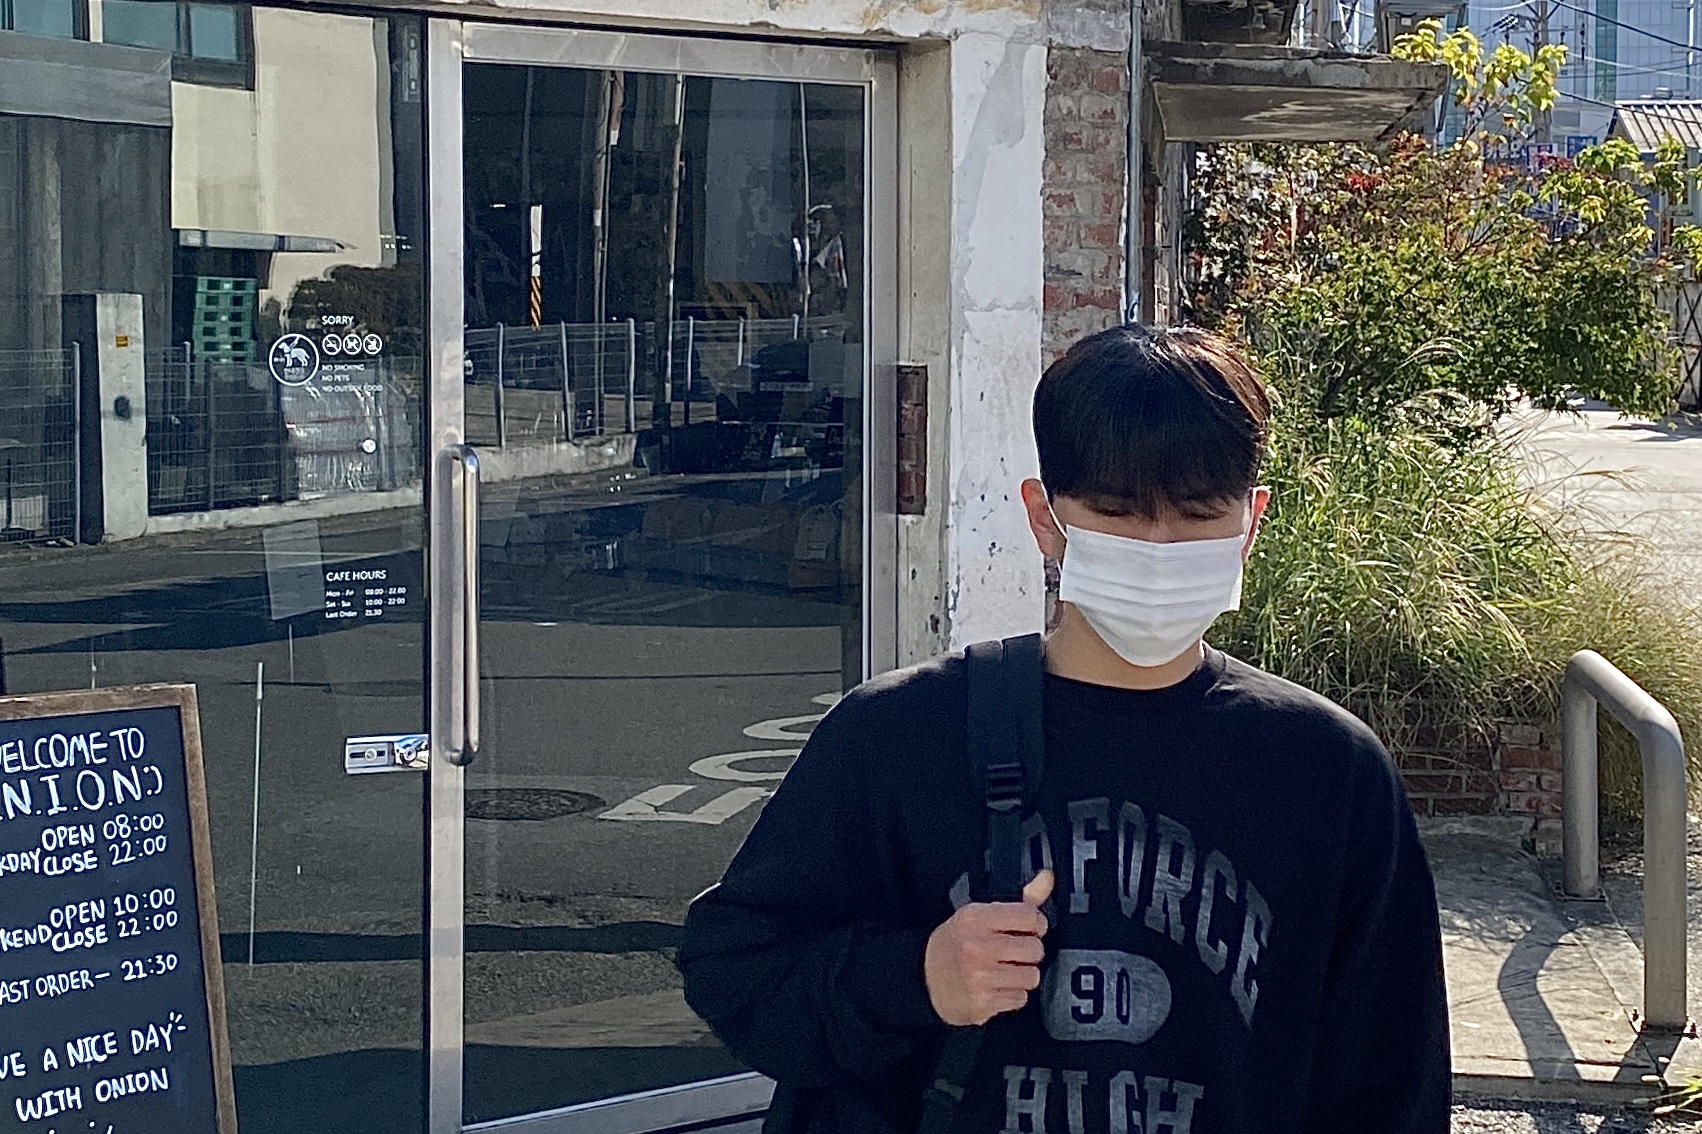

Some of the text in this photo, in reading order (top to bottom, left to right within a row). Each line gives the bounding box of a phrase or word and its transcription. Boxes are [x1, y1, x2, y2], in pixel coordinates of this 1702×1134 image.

[322, 315, 354, 325] SORRY
[321, 374, 350, 382] NO PETS
[326, 570, 387, 581] CAFE HOURS
[325, 600, 336, 608] Sat
[345, 589, 355, 597] Fri
[325, 611, 339, 619] Last
[339, 610, 358, 618] Order
[0, 727, 145, 773] ELCOME TO
[42, 813, 164, 851] OPEN 08:00
[109, 835, 167, 865] 22:00
[50, 888, 175, 929] OPEN 10:00
[118, 910, 178, 938] 22:00
[0, 979, 30, 1005] AST
[120, 953, 178, 981] 21:30
[1070, 965, 1131, 1025] 90
[43, 1047, 58, 1072] A
[66, 1031, 118, 1068] NICE
[131, 1023, 173, 1054] DAY
[15, 1067, 169, 1122] WITH ONION
